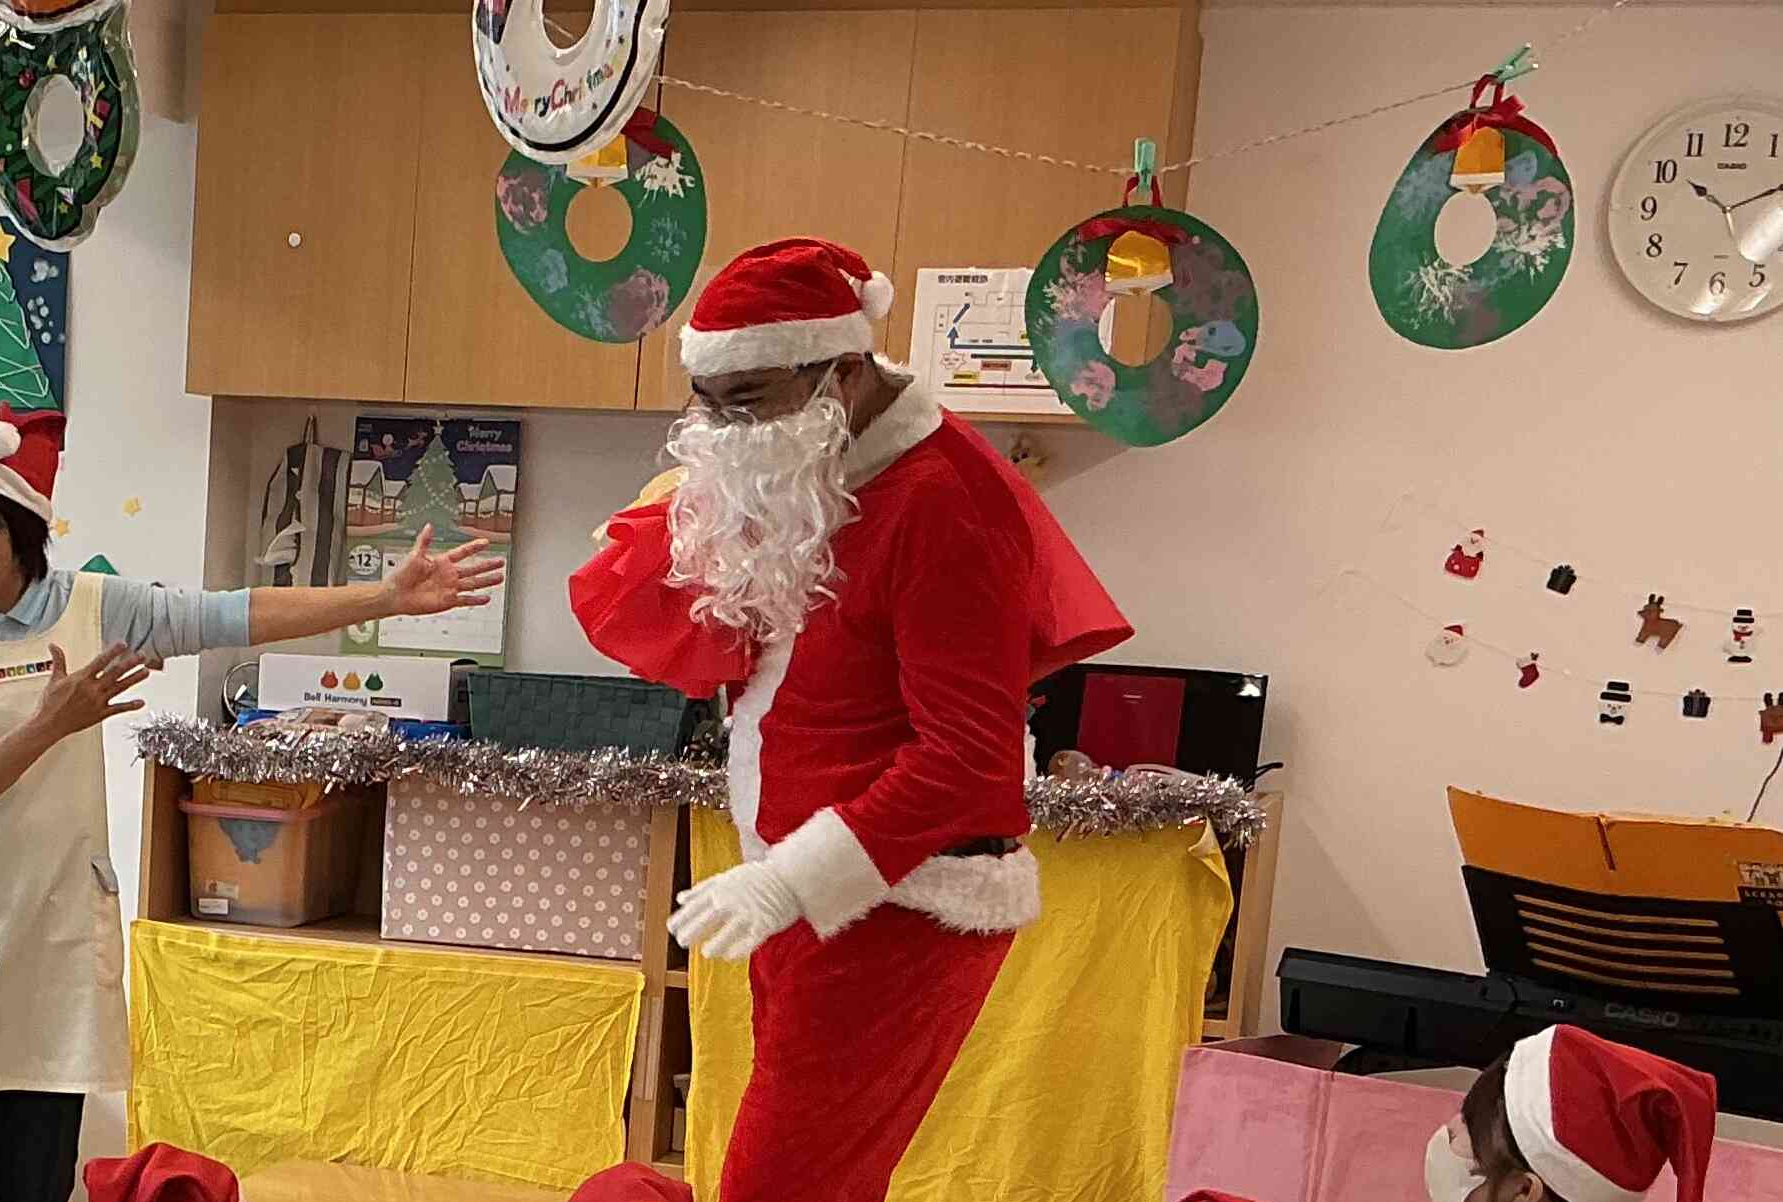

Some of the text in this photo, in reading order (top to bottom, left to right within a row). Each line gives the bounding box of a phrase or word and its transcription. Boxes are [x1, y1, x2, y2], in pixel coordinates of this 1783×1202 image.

[504, 85, 551, 117] Mery
[1685, 133, 1704, 158] 11
[1722, 123, 1750, 148] 12
[1769, 133, 1779, 158] 1
[1653, 158, 1678, 184] 10
[1640, 196, 1658, 221] 9
[1646, 232, 1663, 258] 8
[1673, 261, 1689, 286] 7
[1709, 271, 1726, 295] 6
[1749, 263, 1766, 288] 5
[356, 552, 372, 568] 12
[304, 691, 322, 702] Bell
[324, 693, 368, 707] Harmony
[1603, 1002, 1681, 1028] CASIO
